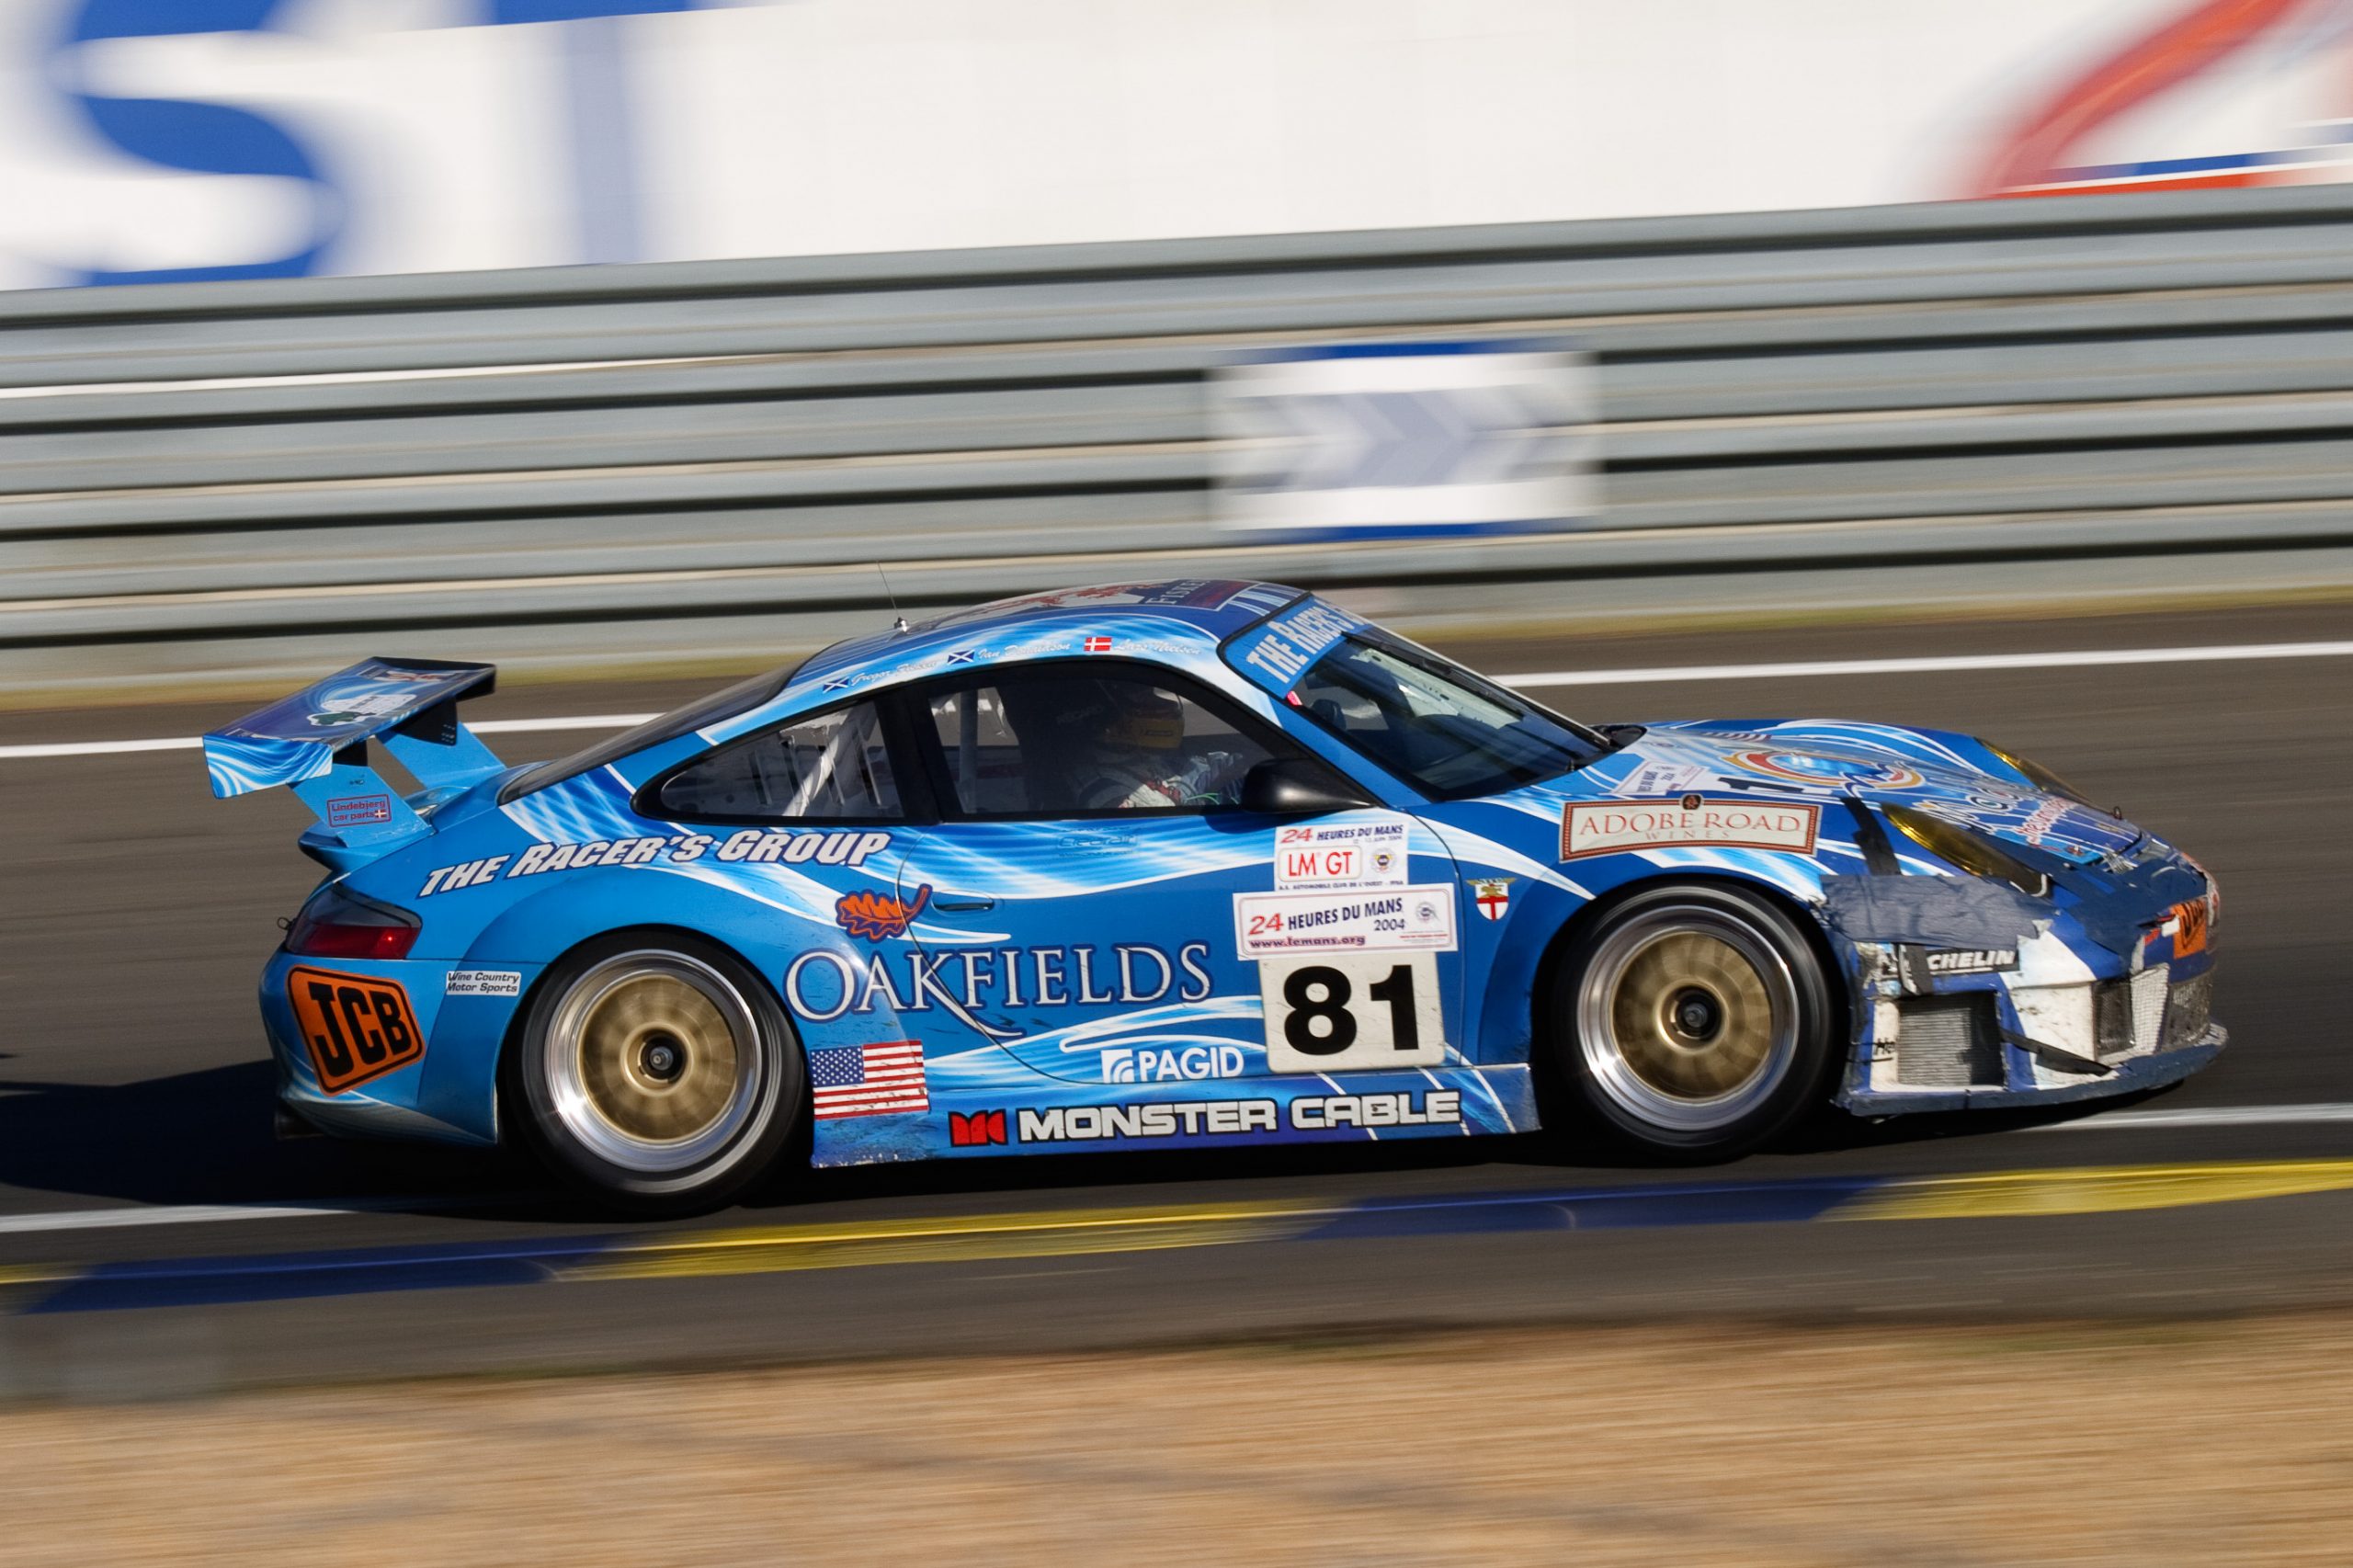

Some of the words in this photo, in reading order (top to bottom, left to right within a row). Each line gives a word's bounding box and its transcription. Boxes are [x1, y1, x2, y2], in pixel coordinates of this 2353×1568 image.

[1245, 633, 1310, 684] THE
[1280, 827, 1313, 844] 24
[1317, 829, 1356, 841] HEURES
[1358, 826, 1373, 837] DU
[1374, 824, 1404, 835] MANS
[1578, 812, 1693, 835] ADOBE
[1704, 812, 1801, 833] ROAD
[1644, 829, 1731, 841] WINES
[416, 854, 508, 898] THE
[507, 833, 715, 878] RACER'S
[718, 829, 891, 867] GROUP
[1288, 852, 1317, 877] LM
[1325, 851, 1354, 876] GT
[1248, 912, 1284, 937] 24
[1288, 908, 1339, 930] HEURES
[1343, 904, 1361, 920] DU
[1364, 897, 1403, 917] MANS
[1373, 918, 1405, 932] 2004
[1927, 949, 2016, 971] CHELIN
[448, 971, 472, 982] Wine
[474, 971, 520, 984] Country
[448, 982, 477, 993] Motor
[480, 982, 518, 994] Sports
[785, 944, 1213, 1037] OAKFIELDS
[1283, 963, 1420, 1056] 81
[308, 981, 413, 1078] JCB
[1140, 1046, 1245, 1081] PAGID
[1017, 1100, 1278, 1142] MONSTER
[1291, 1091, 1461, 1131] CABLE
